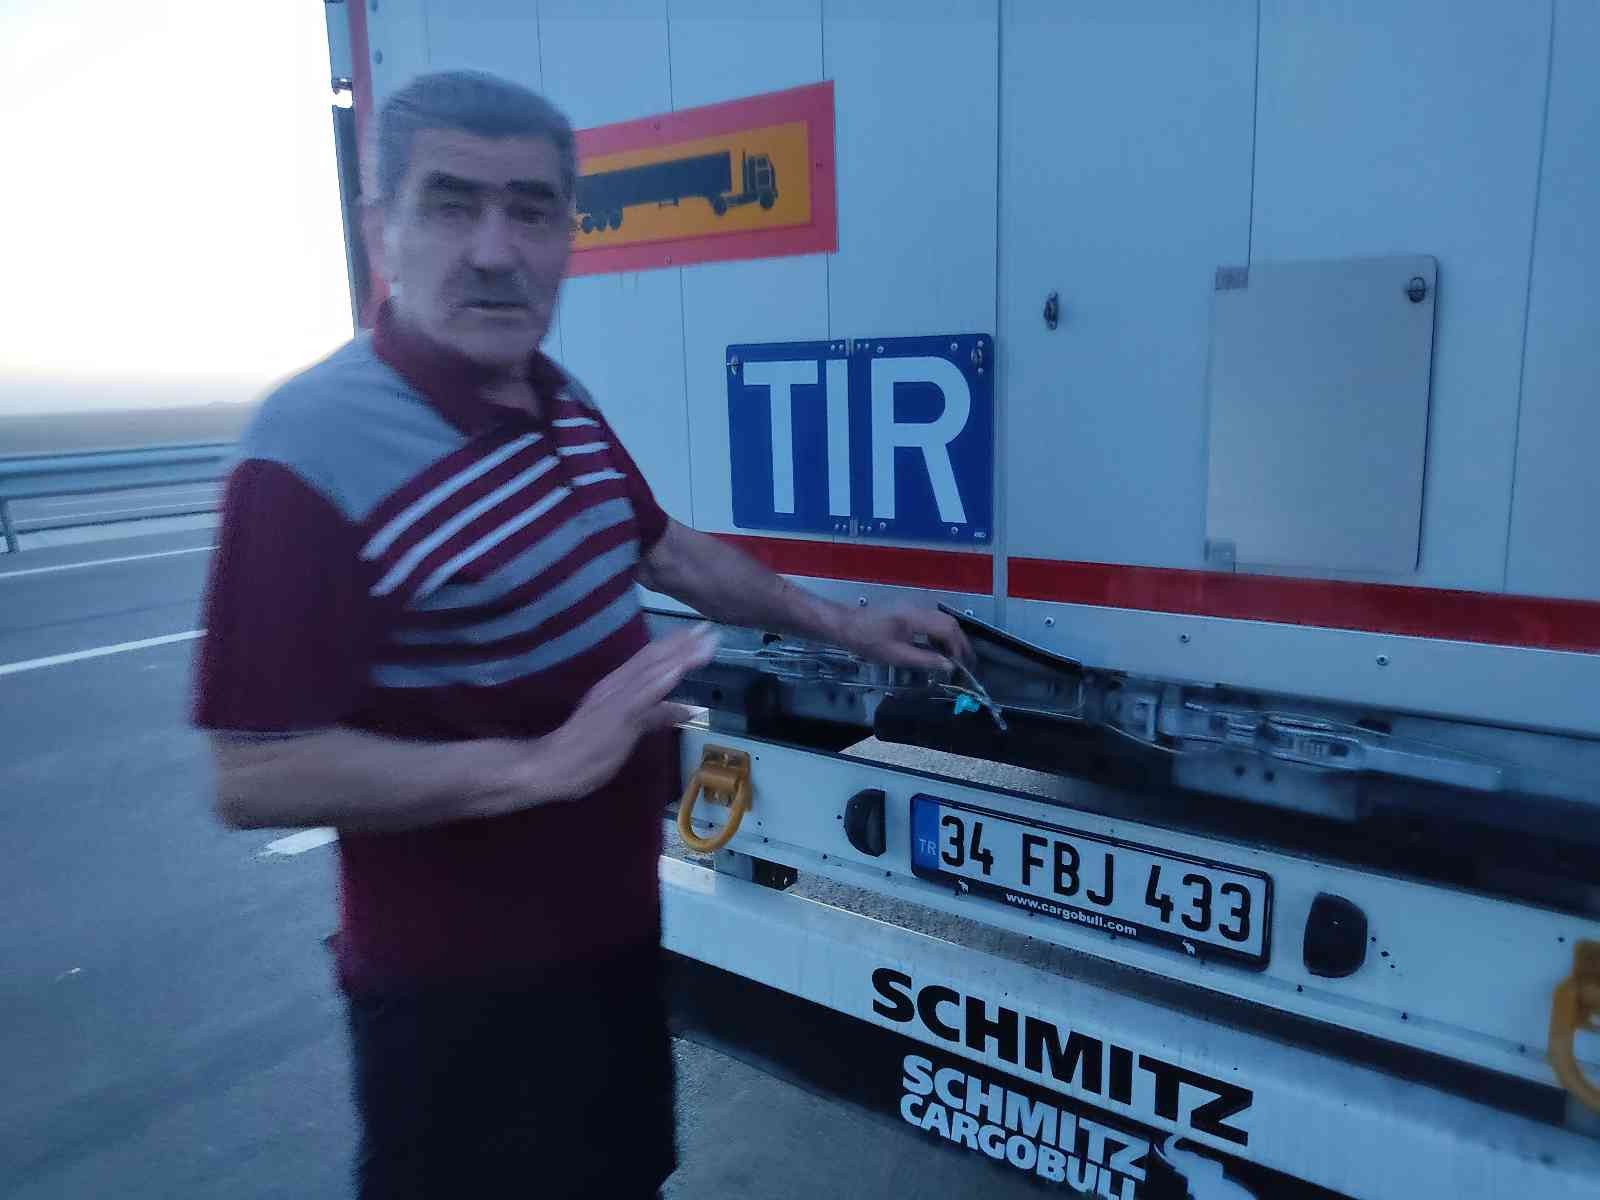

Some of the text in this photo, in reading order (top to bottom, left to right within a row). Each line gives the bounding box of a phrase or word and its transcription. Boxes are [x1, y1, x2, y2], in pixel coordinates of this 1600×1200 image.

[743, 356, 971, 524] TIR
[919, 838, 937, 856] TR
[941, 815, 1252, 943] 34 FBJ 433
[1005, 892, 1138, 937] www.cargobull.com
[871, 967, 1254, 1147] SCHMITZ
[902, 1054, 1150, 1181] SCHMITZ
